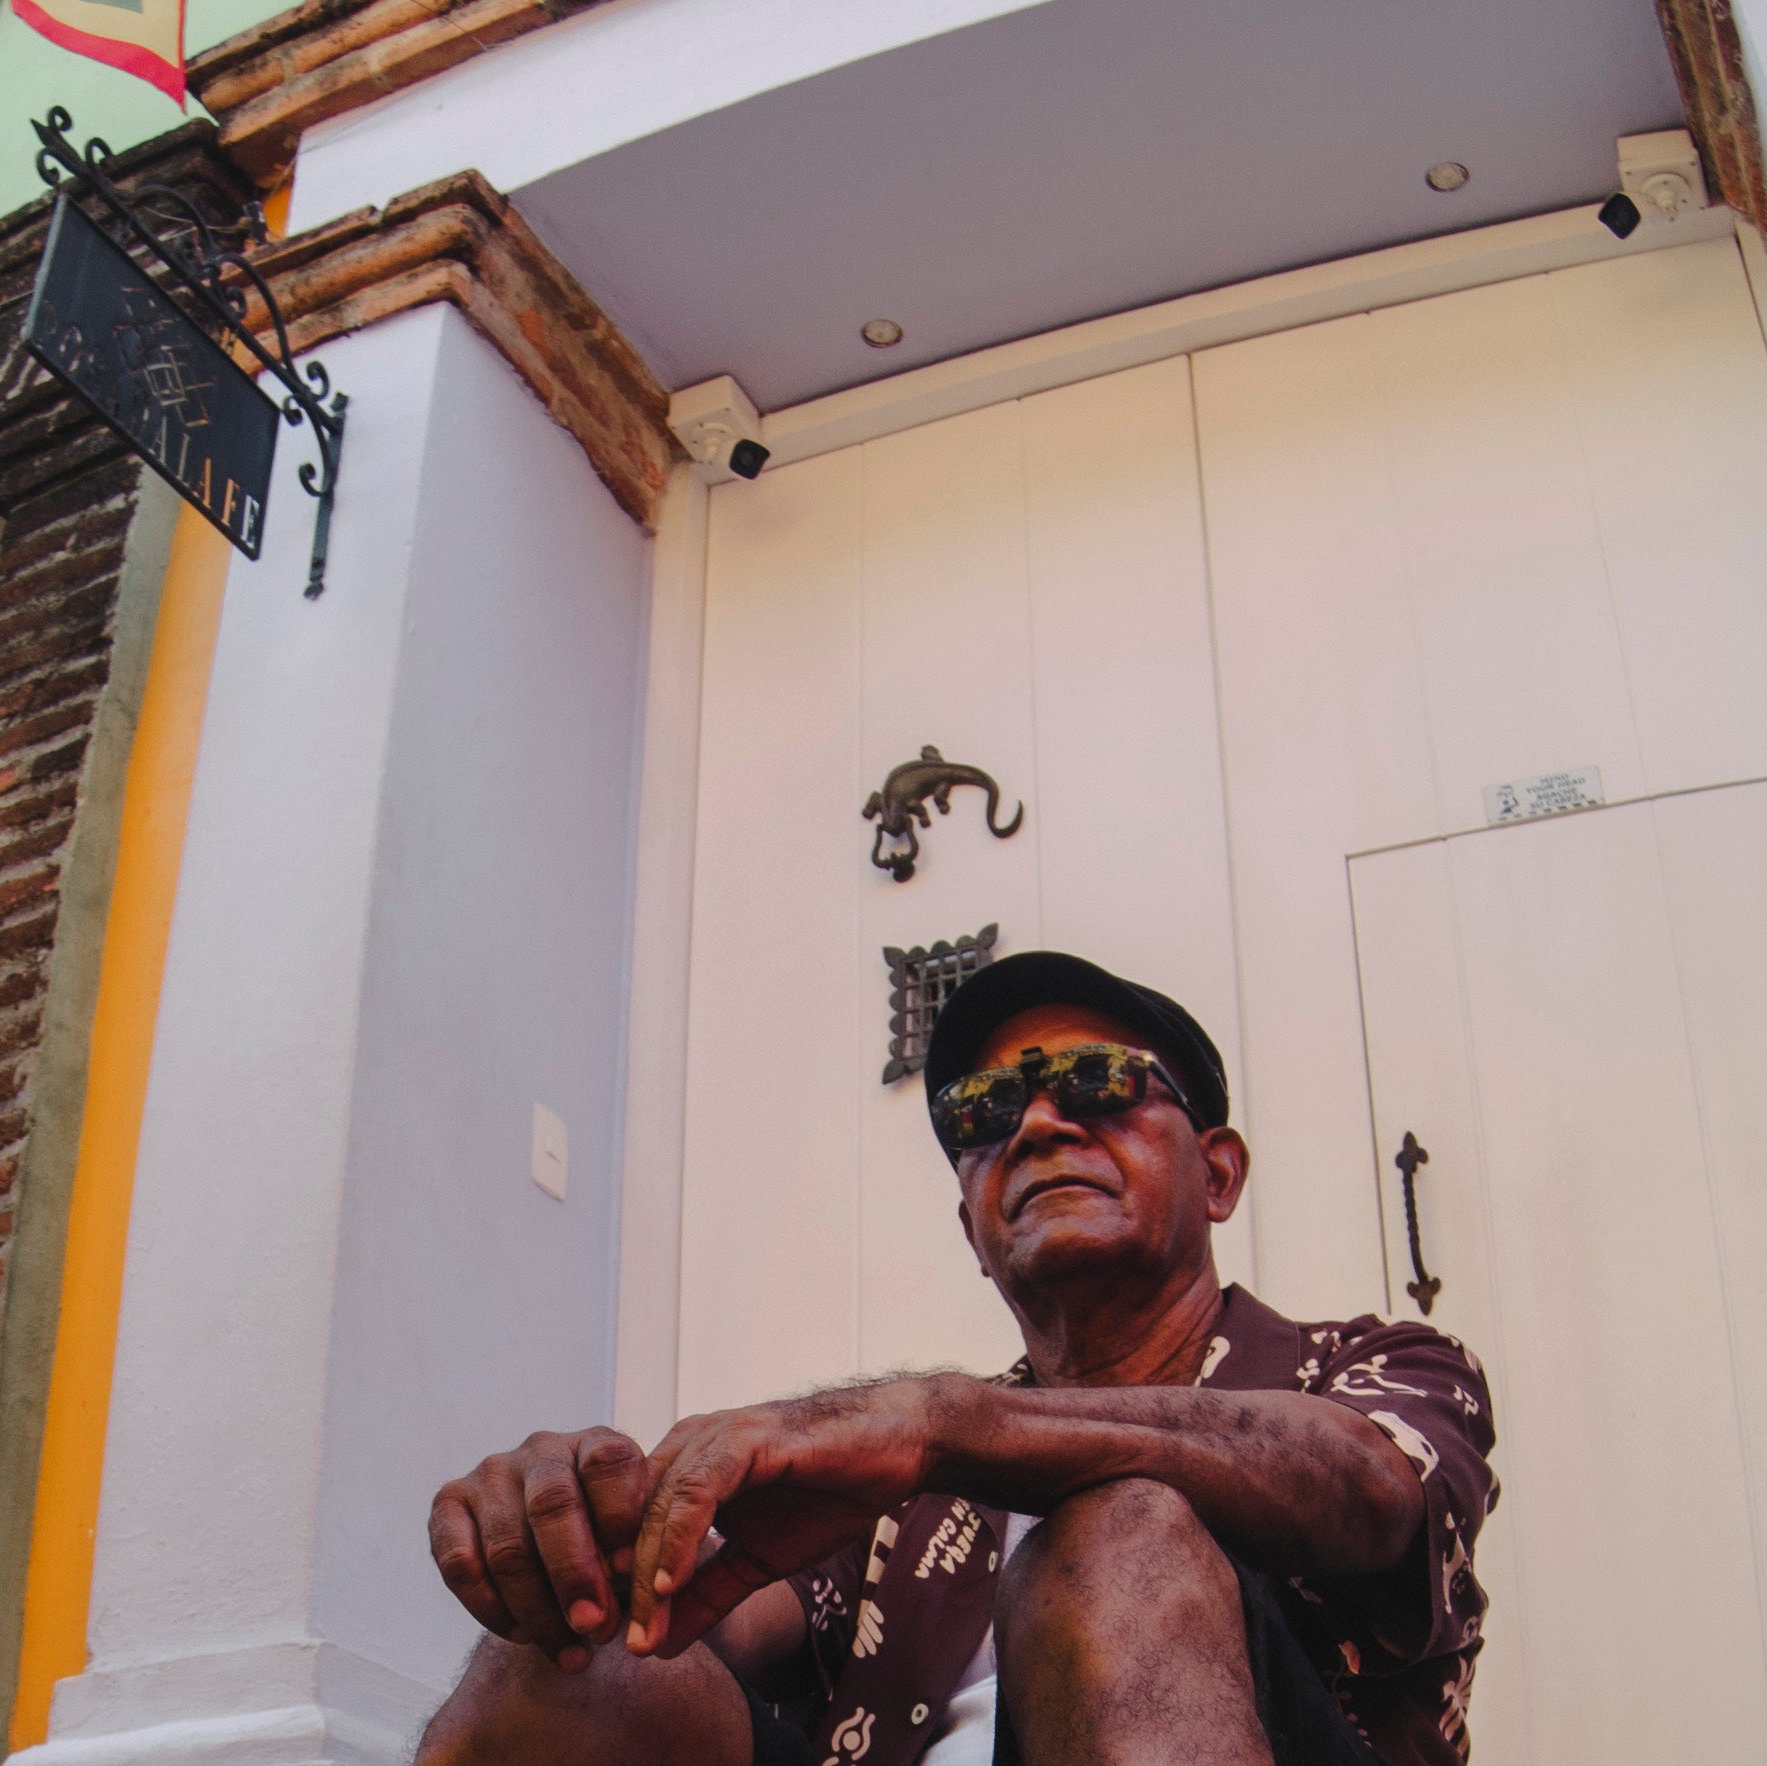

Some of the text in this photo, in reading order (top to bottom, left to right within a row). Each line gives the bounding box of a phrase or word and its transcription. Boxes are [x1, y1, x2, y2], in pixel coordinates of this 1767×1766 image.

[1526, 777, 1585, 794] YOUR HEAD
[1529, 801, 1543, 810] SU
[914, 1517, 957, 1579] CALMA
[939, 1511, 982, 1575] JUEGA
